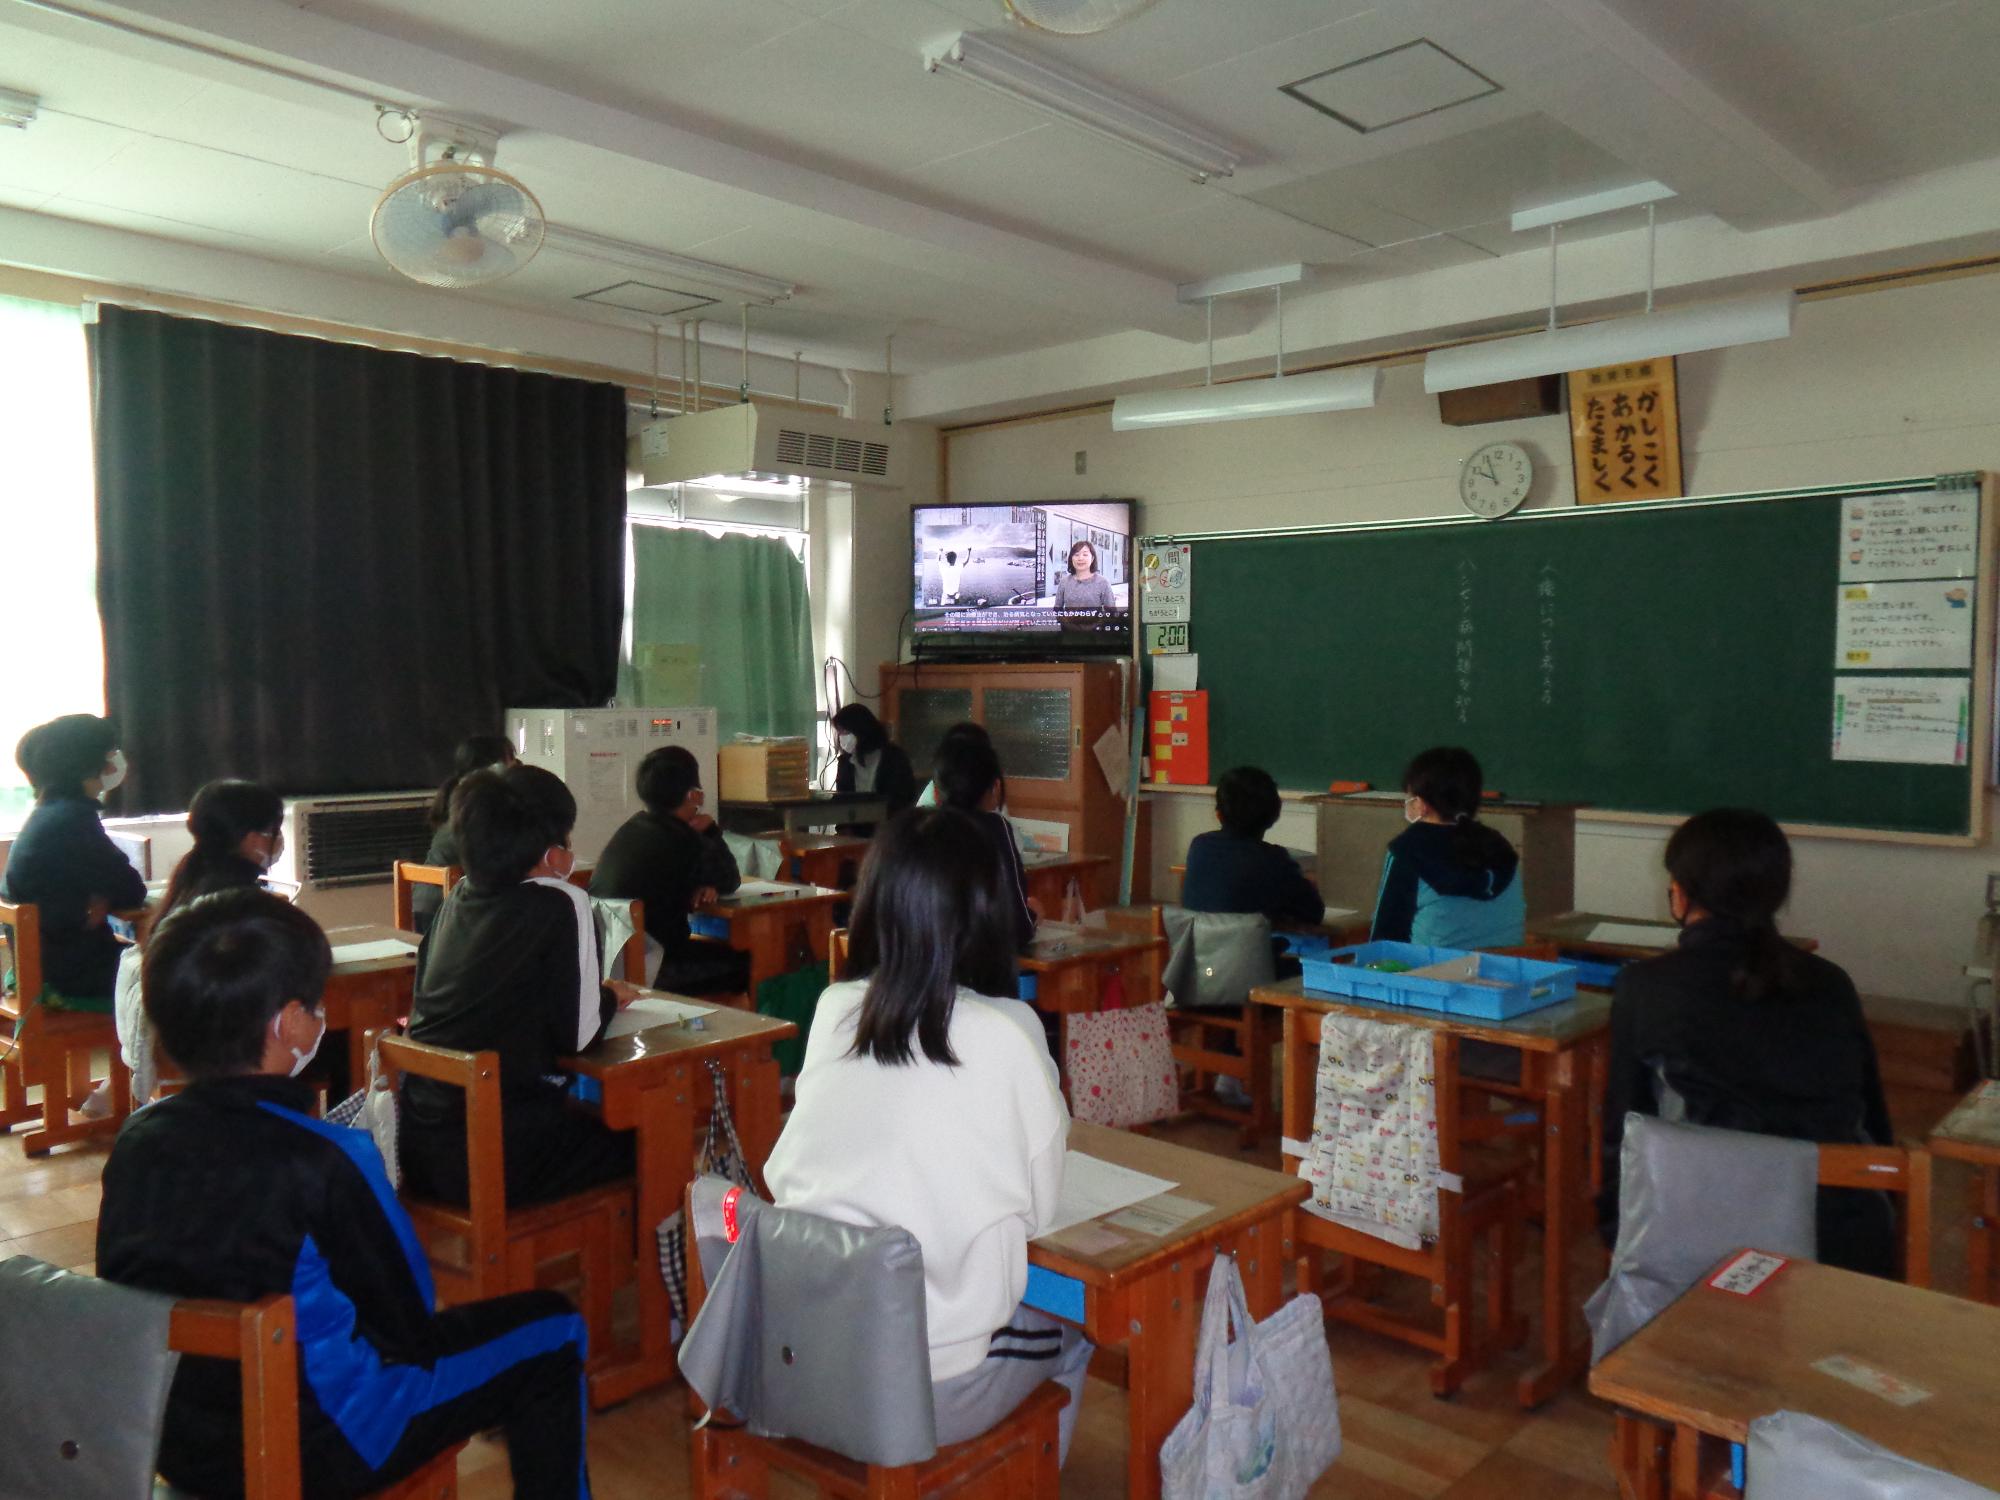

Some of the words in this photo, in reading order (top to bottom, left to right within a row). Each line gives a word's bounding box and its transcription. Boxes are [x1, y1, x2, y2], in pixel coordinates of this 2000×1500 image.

[1586, 396, 1612, 492] たくましく
[1611, 392, 1638, 489] あかるく
[1637, 389, 1660, 487] かしこく
[1168, 551, 1179, 565] 問
[1158, 626, 1185, 646] 2:00
